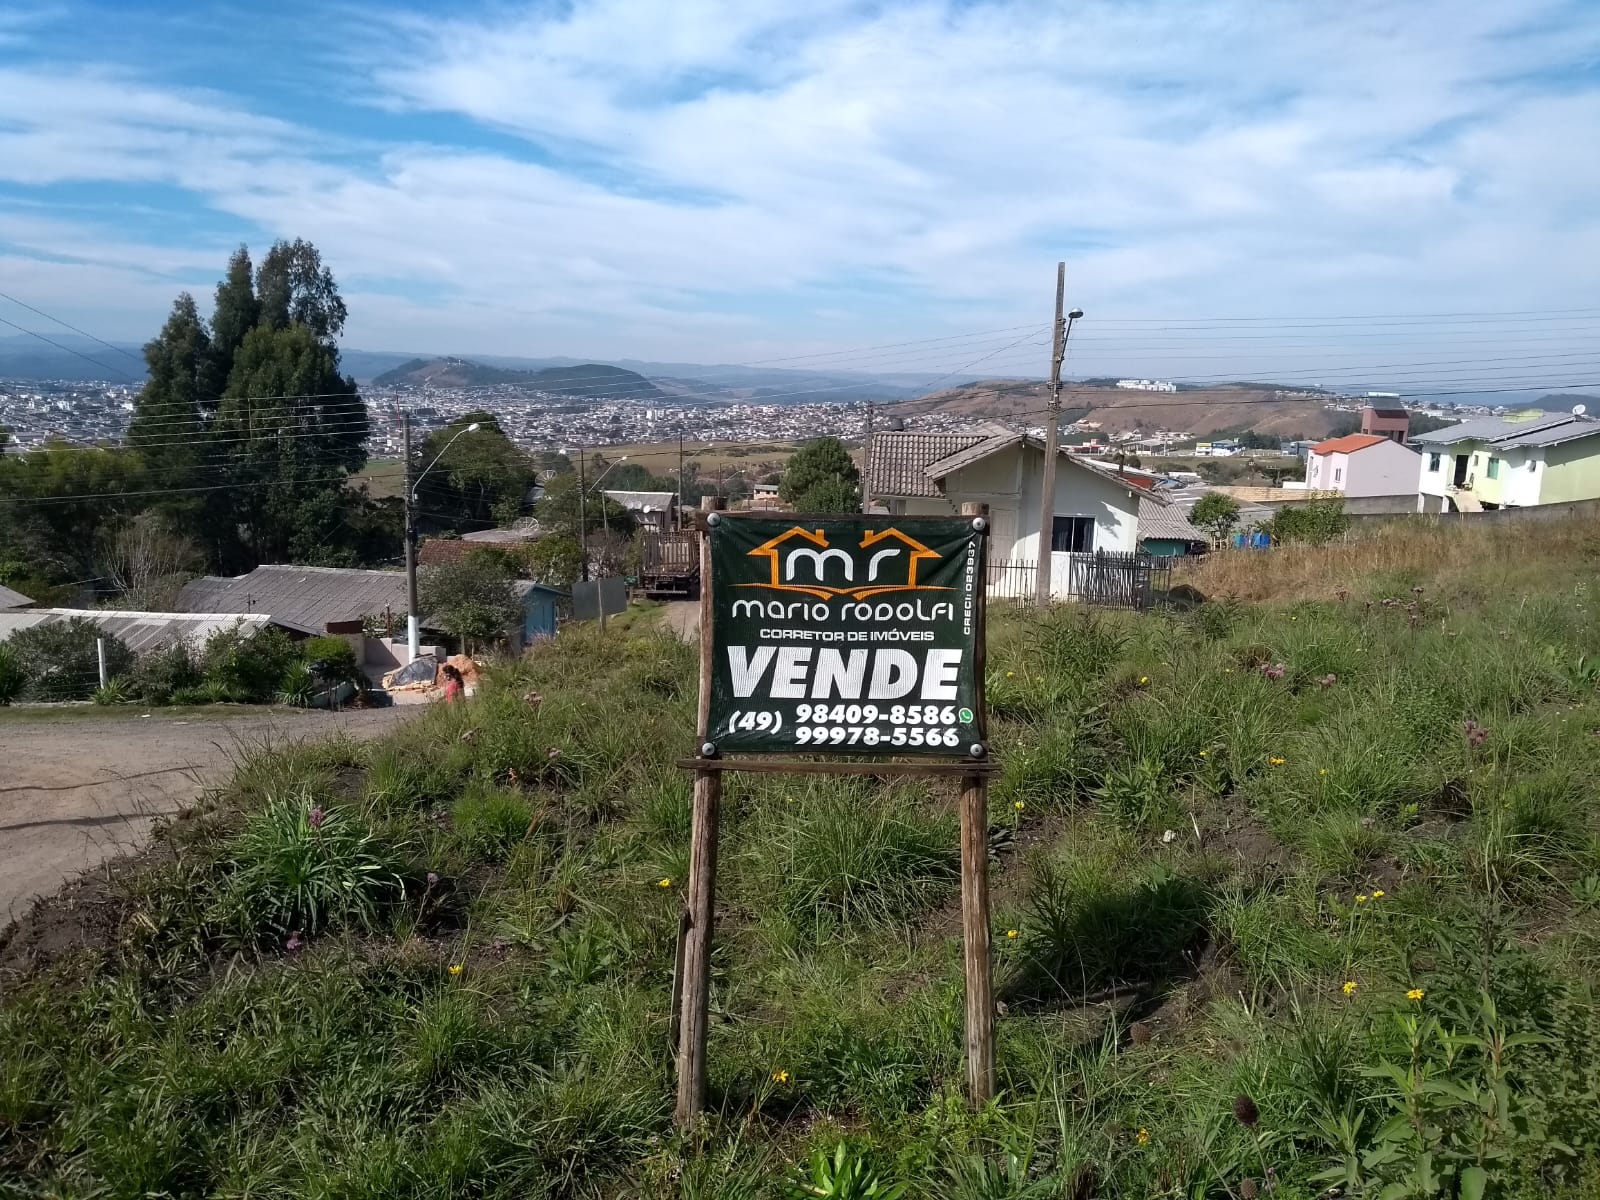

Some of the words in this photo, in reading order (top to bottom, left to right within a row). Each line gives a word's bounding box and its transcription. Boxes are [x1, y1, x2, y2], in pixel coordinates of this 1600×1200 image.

[760, 629, 845, 642] CORRETOR
[848, 631, 868, 642] DE
[870, 628, 935, 641] IMÓVEIS
[728, 646, 963, 700] VENDE
[729, 710, 783, 735] (49)
[796, 704, 957, 724] 98409-8586
[795, 727, 960, 747] 99978-5566
